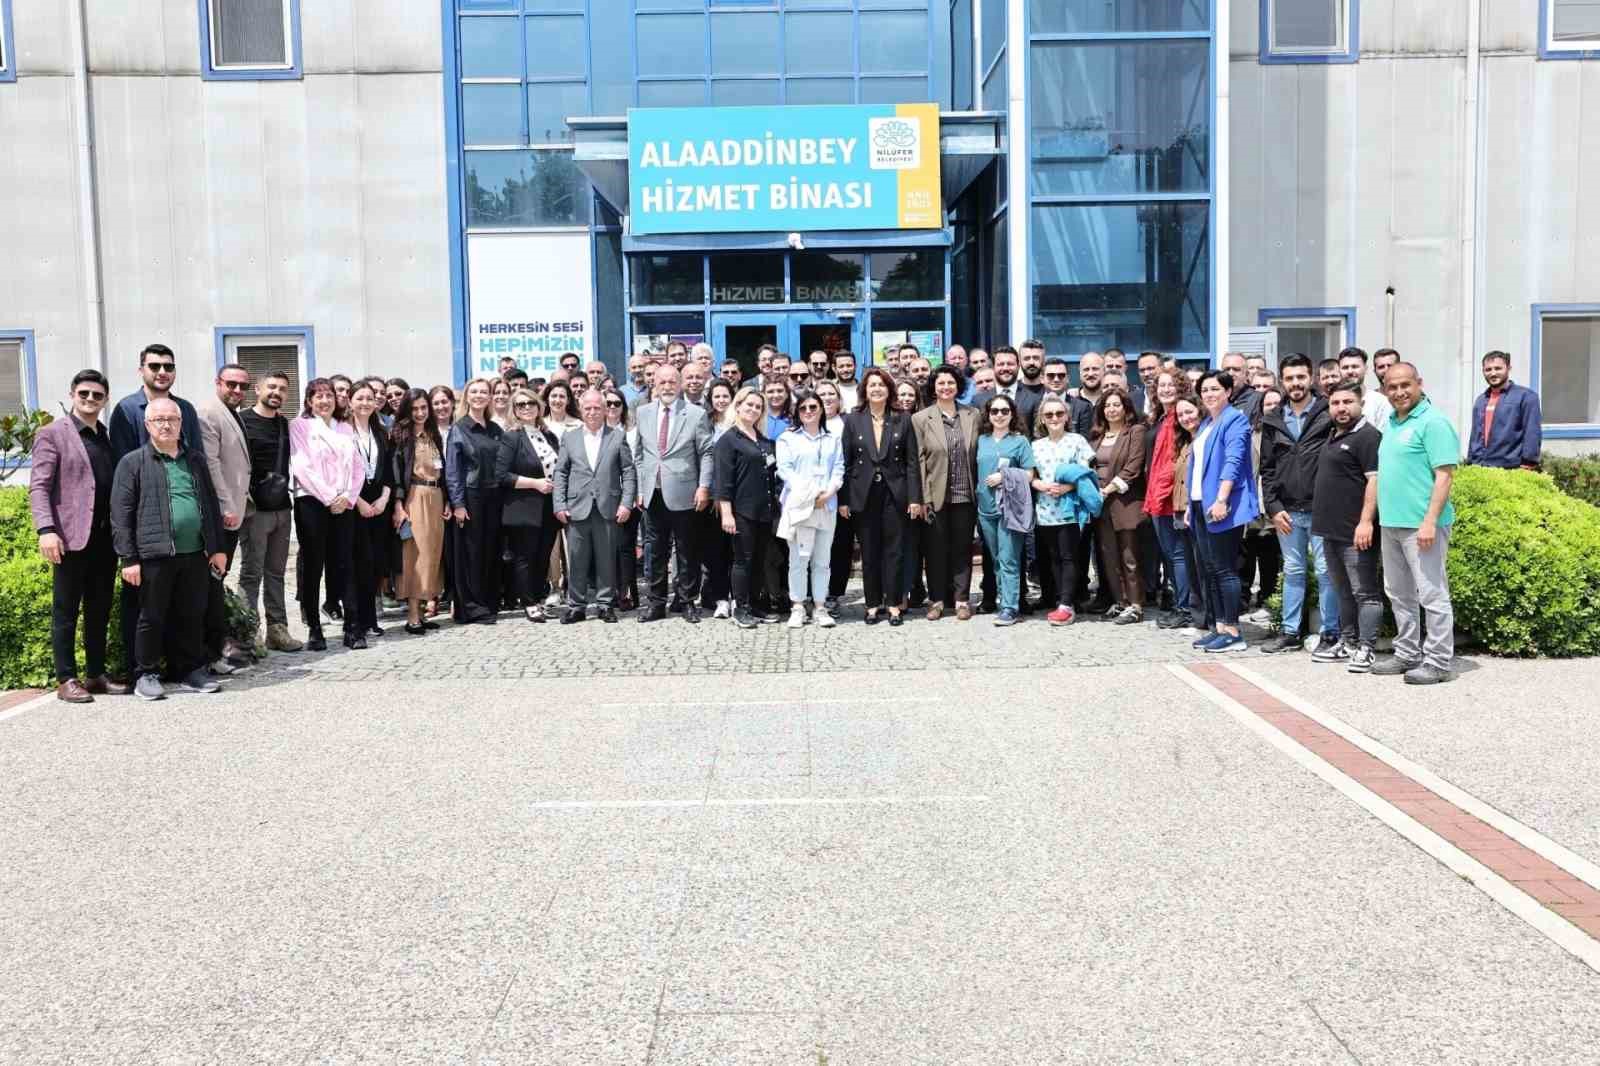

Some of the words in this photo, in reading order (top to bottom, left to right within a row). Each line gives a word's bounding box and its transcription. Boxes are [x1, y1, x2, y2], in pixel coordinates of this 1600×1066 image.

[640, 131, 857, 168] ALAADDİNBEY
[876, 147, 913, 156] NİLÜFER
[642, 178, 760, 213] HİZMET
[769, 176, 872, 210] BİNASI
[479, 321, 549, 334] HERKESİN
[552, 320, 584, 333] SESİ
[479, 335, 584, 353] HEPİMİZİN
[480, 353, 585, 371] NİÜFEİ
